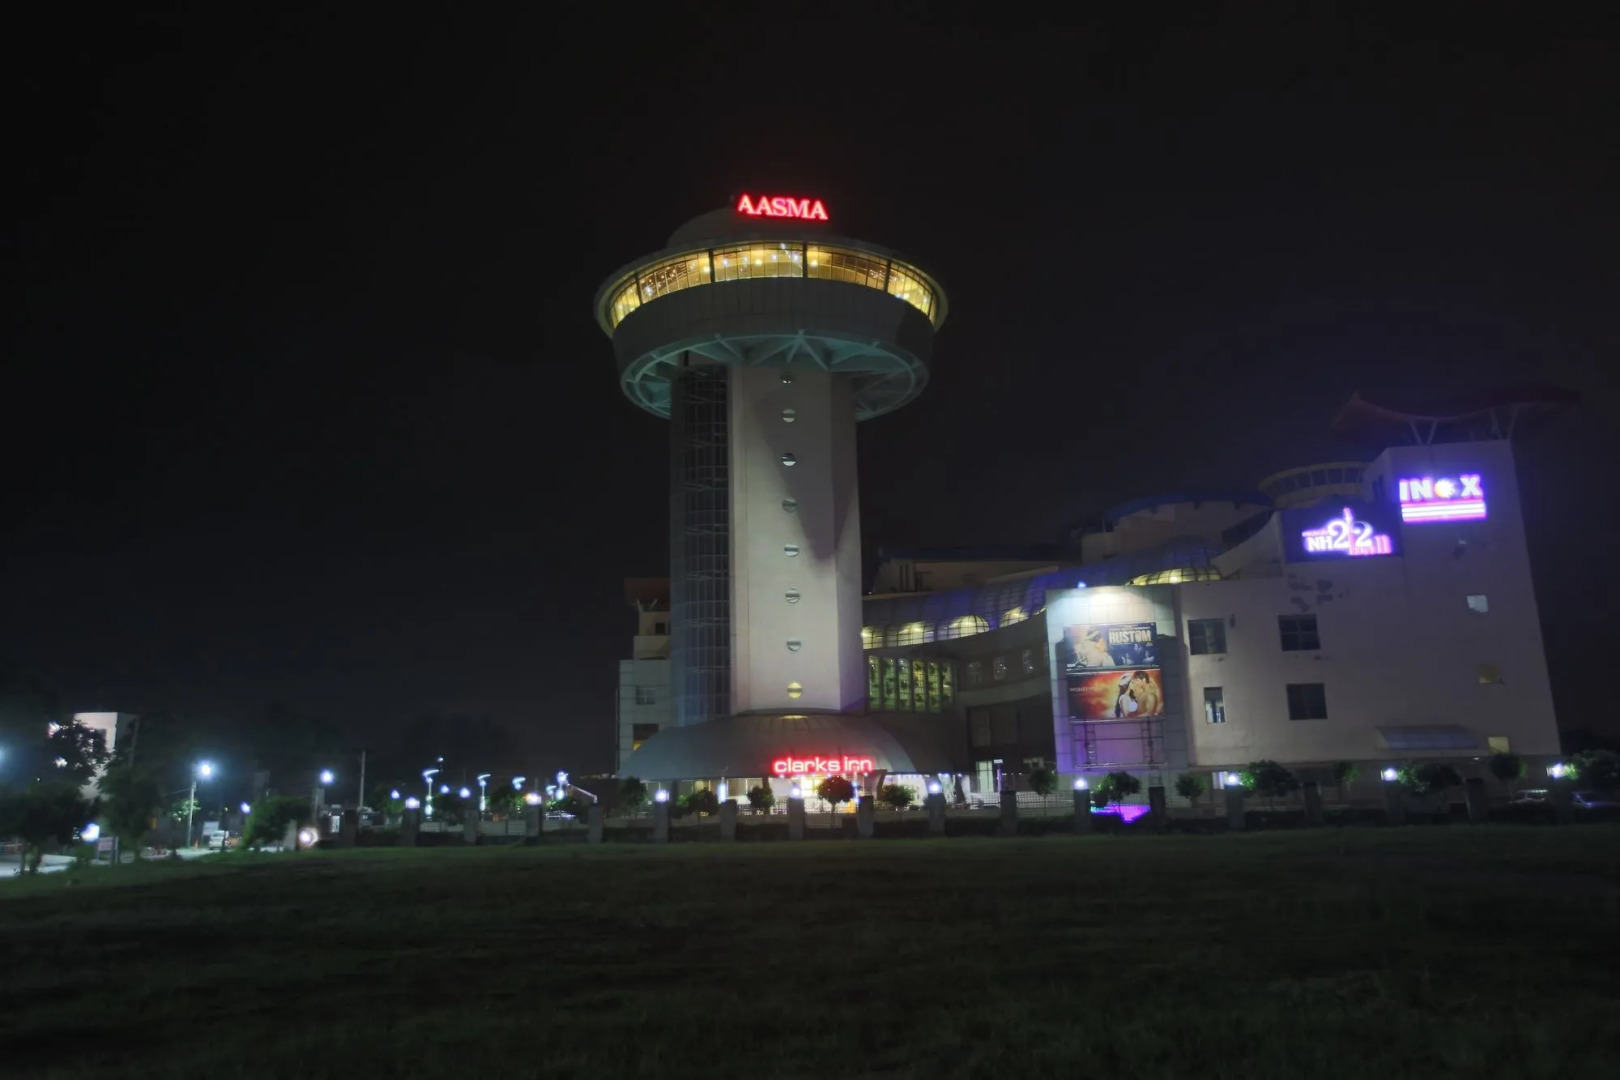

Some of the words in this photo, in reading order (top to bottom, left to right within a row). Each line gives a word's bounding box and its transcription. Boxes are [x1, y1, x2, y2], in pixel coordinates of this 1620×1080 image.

[738, 194, 828, 220] AASMA
[1399, 476, 1482, 501] INOX
[1108, 629, 1152, 644] RUSTOM
[774, 757, 840, 773] clarks
[844, 756, 872, 772] inn
